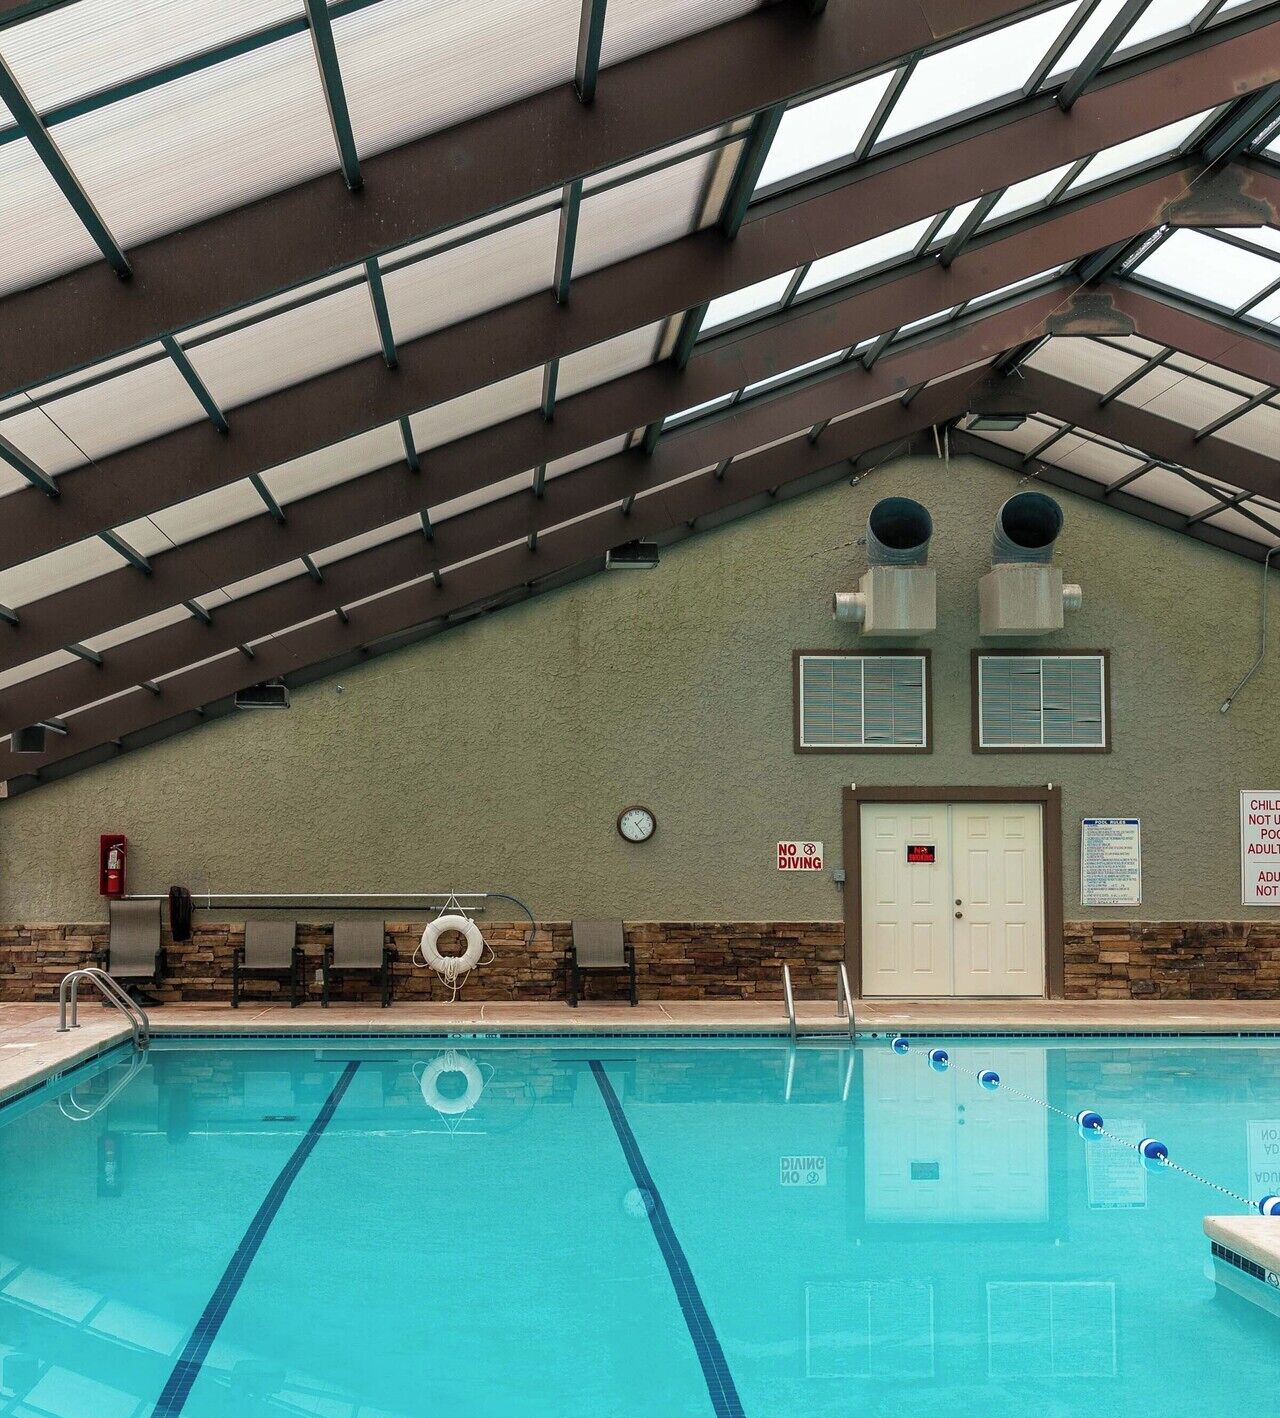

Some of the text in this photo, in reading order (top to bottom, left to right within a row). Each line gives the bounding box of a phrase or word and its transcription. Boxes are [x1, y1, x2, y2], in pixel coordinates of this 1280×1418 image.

[1248, 814, 1271, 825] NOT
[779, 844, 797, 856] NO
[779, 857, 822, 869] DIVING
[1256, 885, 1278, 896] NOT
